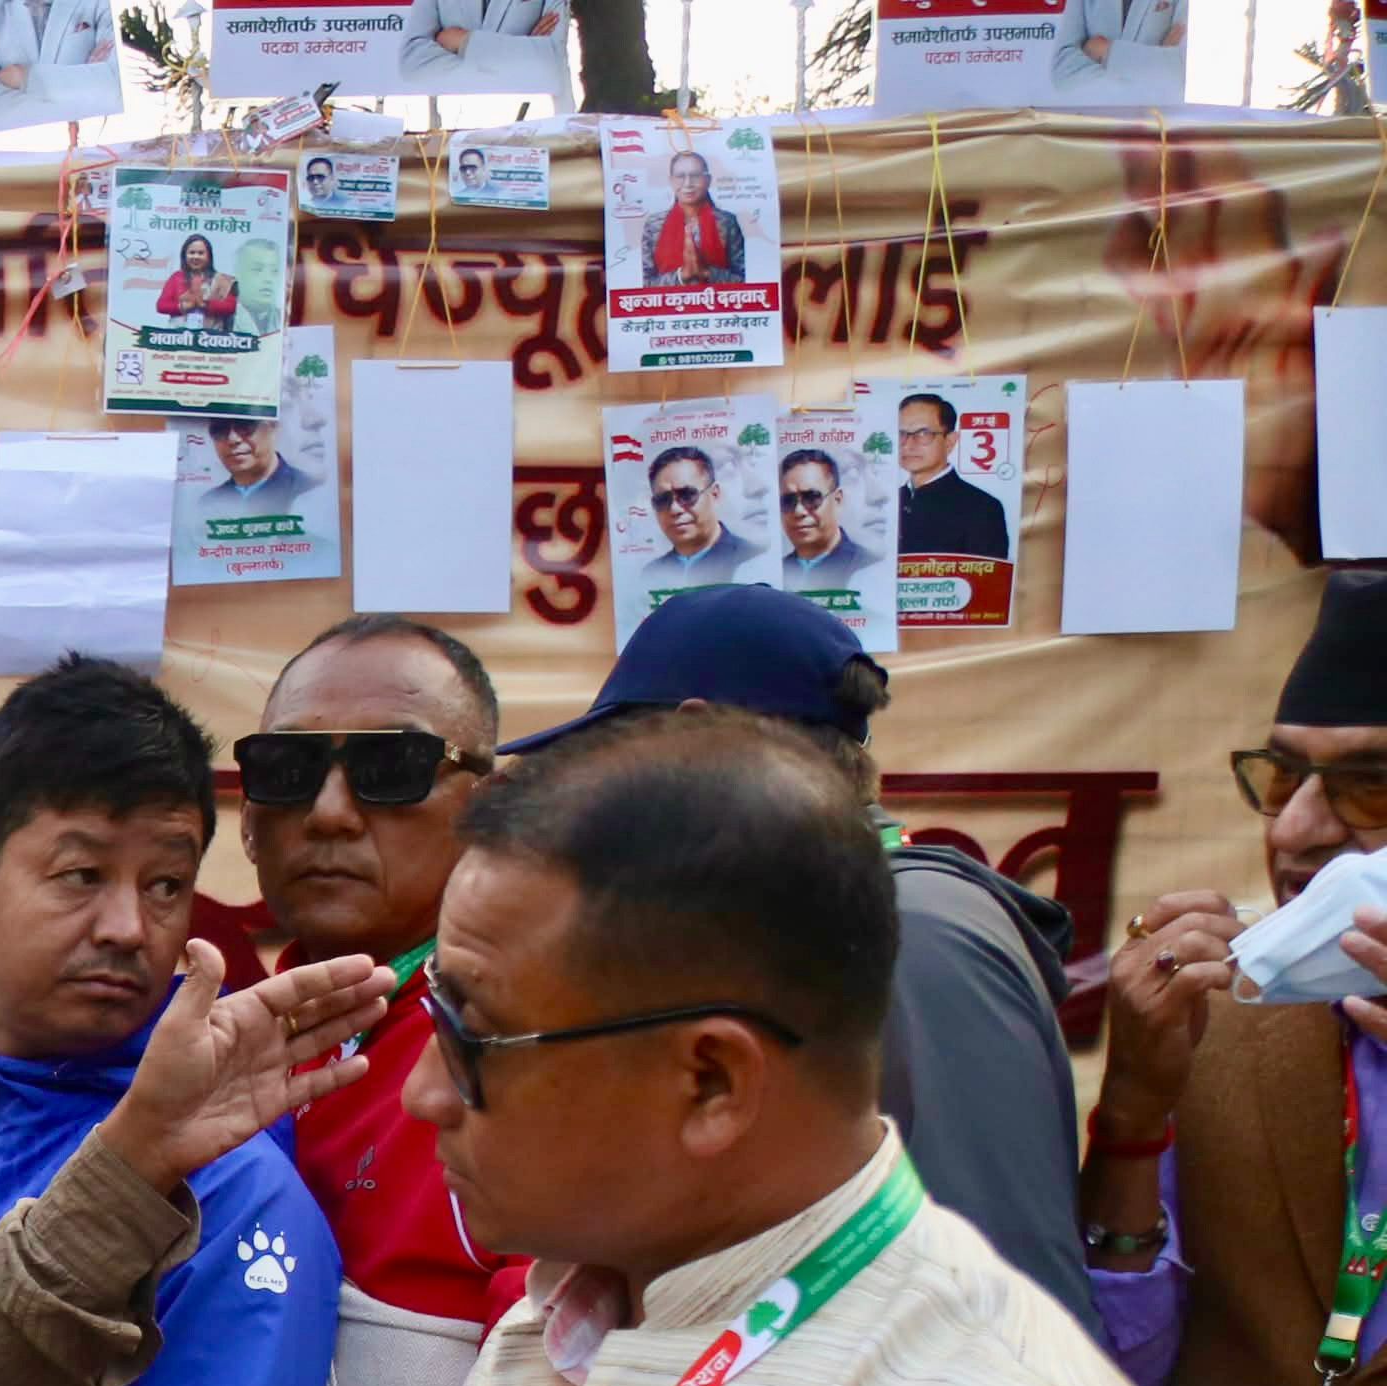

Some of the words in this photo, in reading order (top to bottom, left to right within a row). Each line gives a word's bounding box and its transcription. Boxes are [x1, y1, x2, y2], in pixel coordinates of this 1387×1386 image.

[227, 15, 316, 35] समावेशीतर्फ
[323, 14, 403, 33] उपसभापति
[891, 26, 976, 46] समावेशीतर्फ
[982, 22, 1055, 41] उपसभापति
[261, 41, 299, 55] पदका
[304, 38, 367, 55] उम्मेदवार
[925, 51, 960, 65] पदका
[966, 47, 1023, 64] उम्मेदवार
[149, 215, 198, 232] नेपाली
[665, 287, 715, 311] कुमारी
[621, 318, 666, 334] केन्द्रीय
[671, 318, 710, 331] सदस्य
[714, 314, 770, 329] उम्मेदवार
[149, 330, 193, 347] भवानी
[198, 330, 253, 349] देवकोटा
[650, 427, 686, 444] नेपाली
[779, 430, 814, 445] नेपाली
[970, 431, 997, 471] ३
[235, 545, 265, 558] सदस्य
[267, 542, 312, 557] उम्मेदवार
[957, 560, 996, 577] यादव
